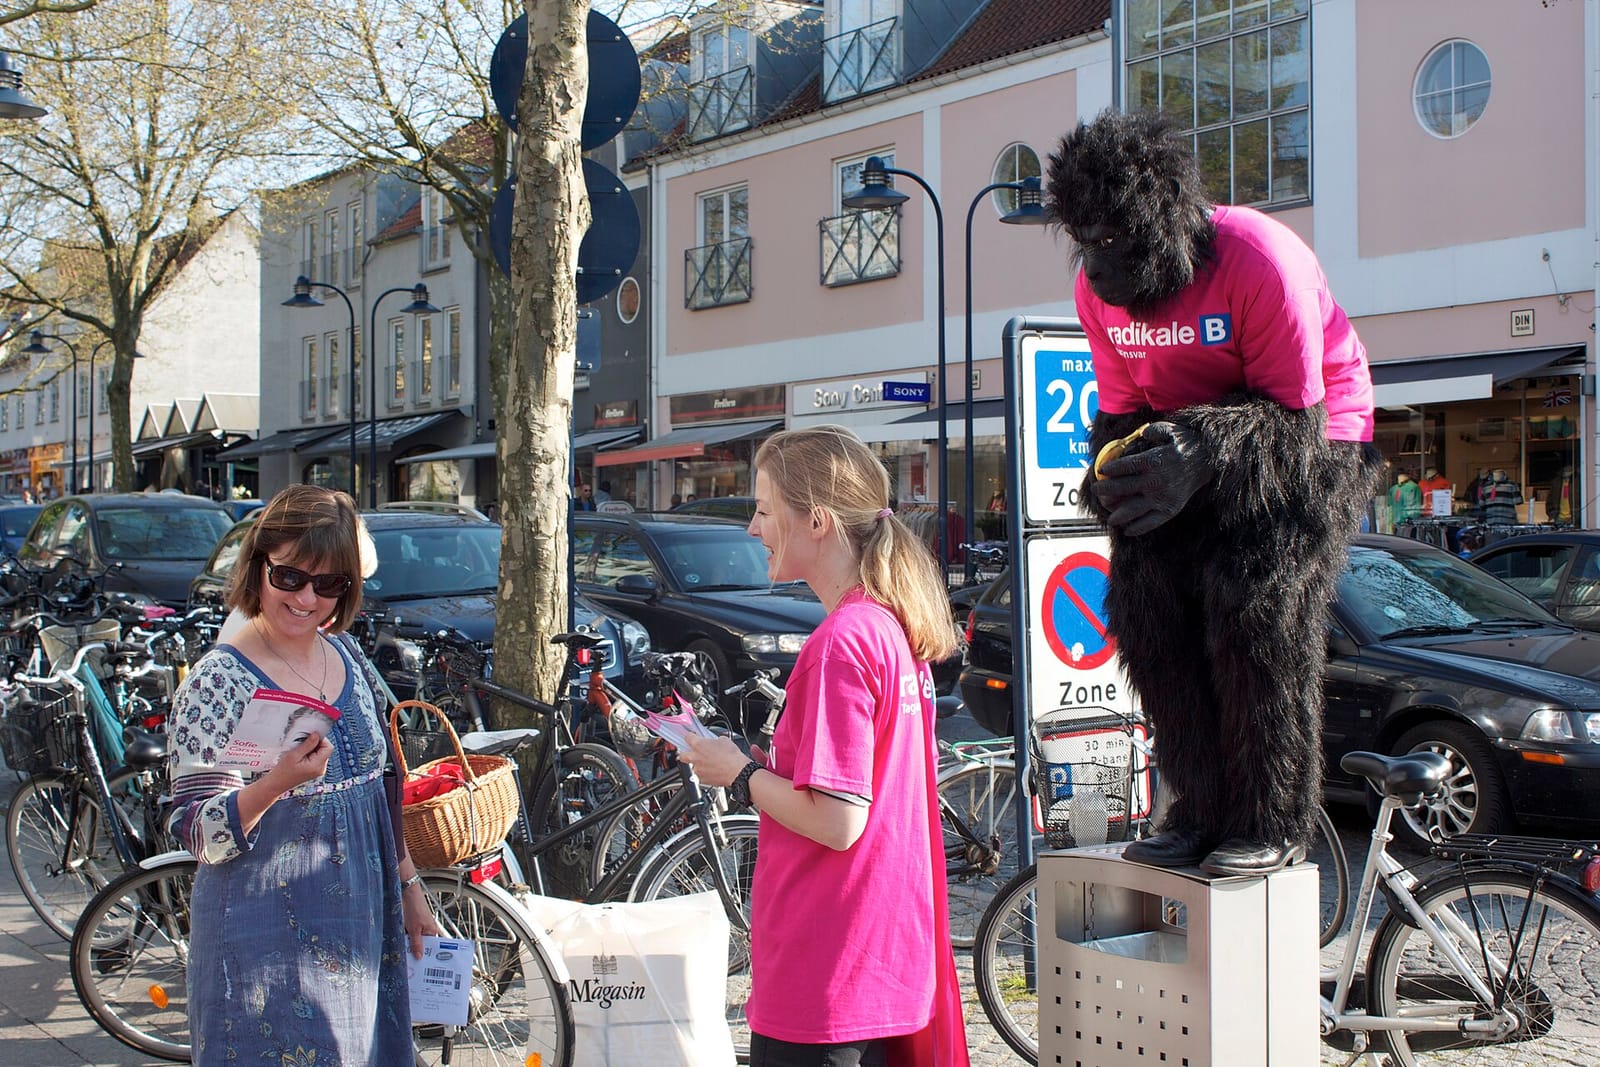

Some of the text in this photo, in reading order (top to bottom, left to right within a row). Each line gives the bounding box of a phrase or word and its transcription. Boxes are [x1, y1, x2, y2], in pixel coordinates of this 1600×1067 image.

[1515, 315, 1530, 326] DIN
[1106, 318, 1226, 347] radikale B
[1062, 359, 1093, 373] max
[813, 387, 847, 408] Sony
[852, 383, 883, 404] Cent
[893, 387, 925, 397] SONY
[1045, 379, 1098, 433] 20
[1052, 482, 1079, 507] Zo
[1059, 681, 1117, 706] Zone
[229, 746, 267, 755] Carsten
[232, 739, 258, 748] Sofie
[1085, 740, 1099, 752] 30
[569, 978, 646, 1009] Magasin
